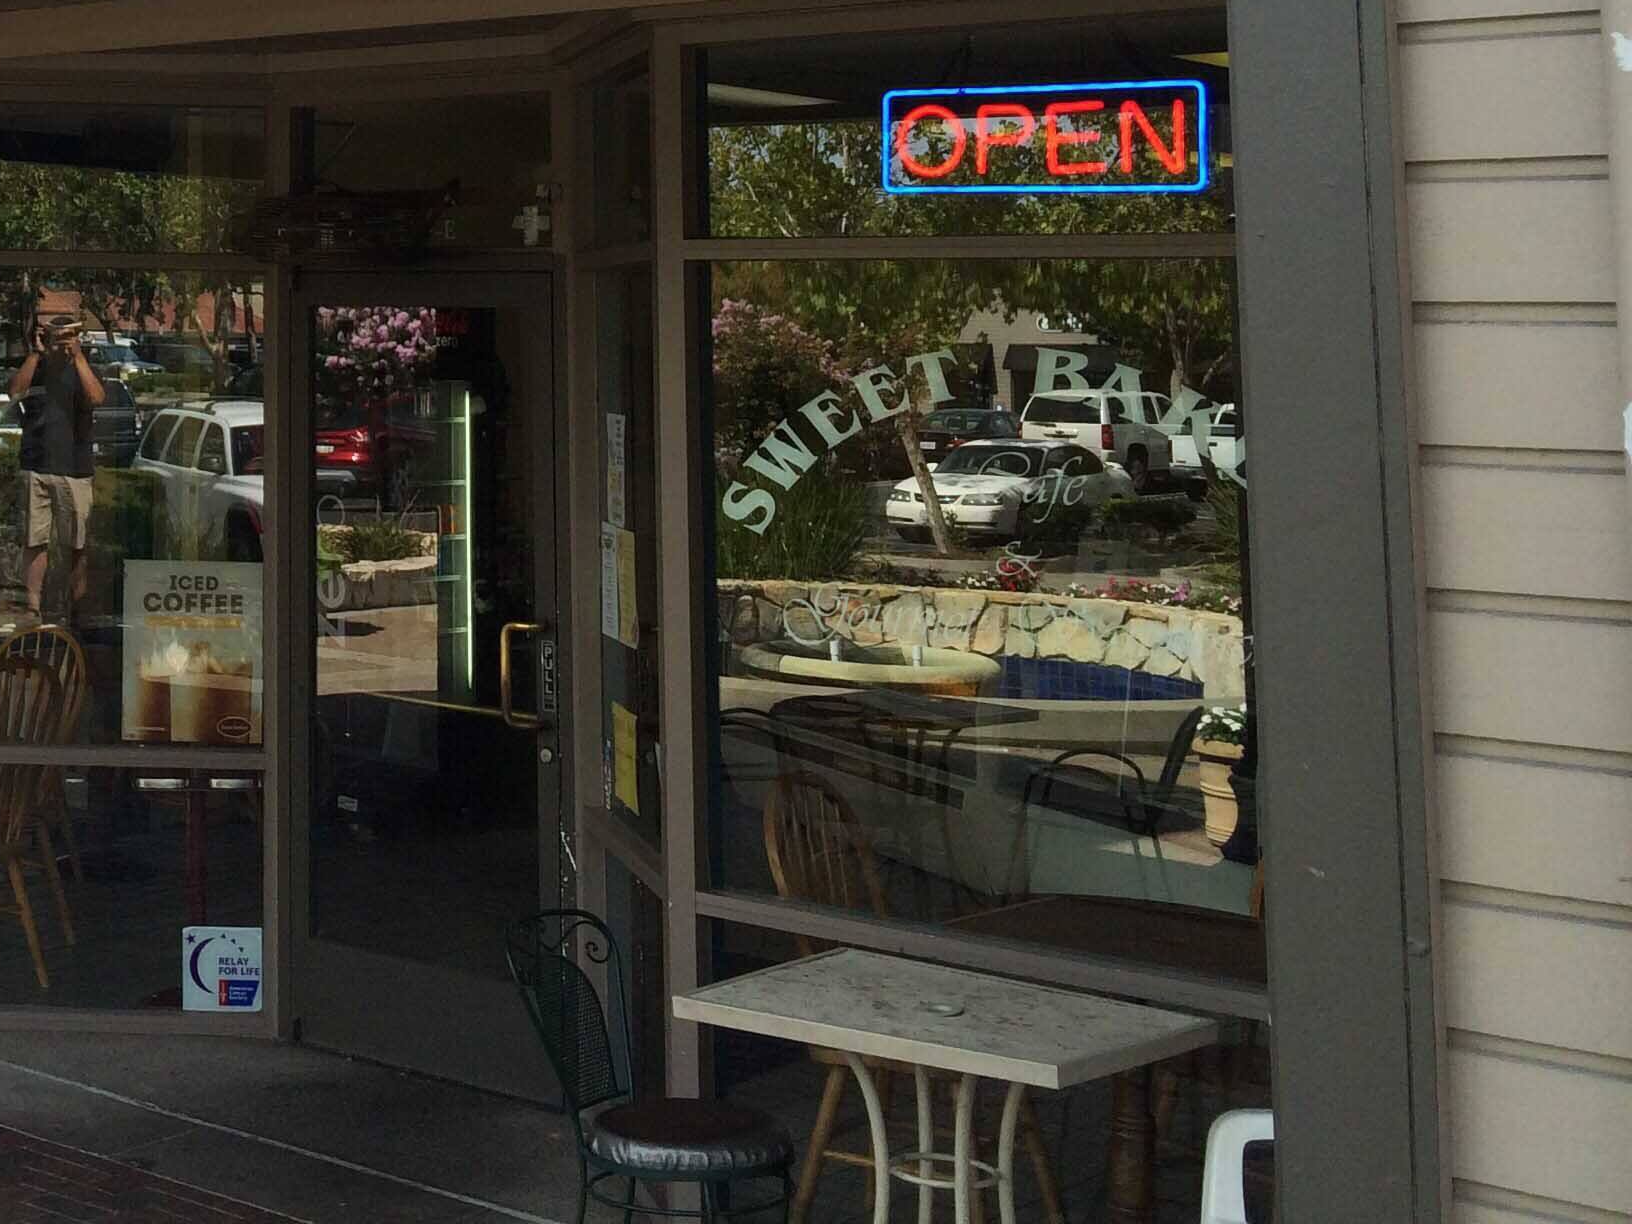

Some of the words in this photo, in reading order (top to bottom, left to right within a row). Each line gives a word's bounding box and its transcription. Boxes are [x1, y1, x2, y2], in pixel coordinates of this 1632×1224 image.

[895, 98, 1186, 179] OPEN
[721, 347, 960, 536] SWEET
[169, 575, 219, 591] ICED
[143, 592, 244, 615] COFFEE
[543, 646, 554, 694] PULL
[218, 957, 249, 966] RELAY
[218, 966, 238, 975] FOR
[240, 967, 260, 976] LIFE
